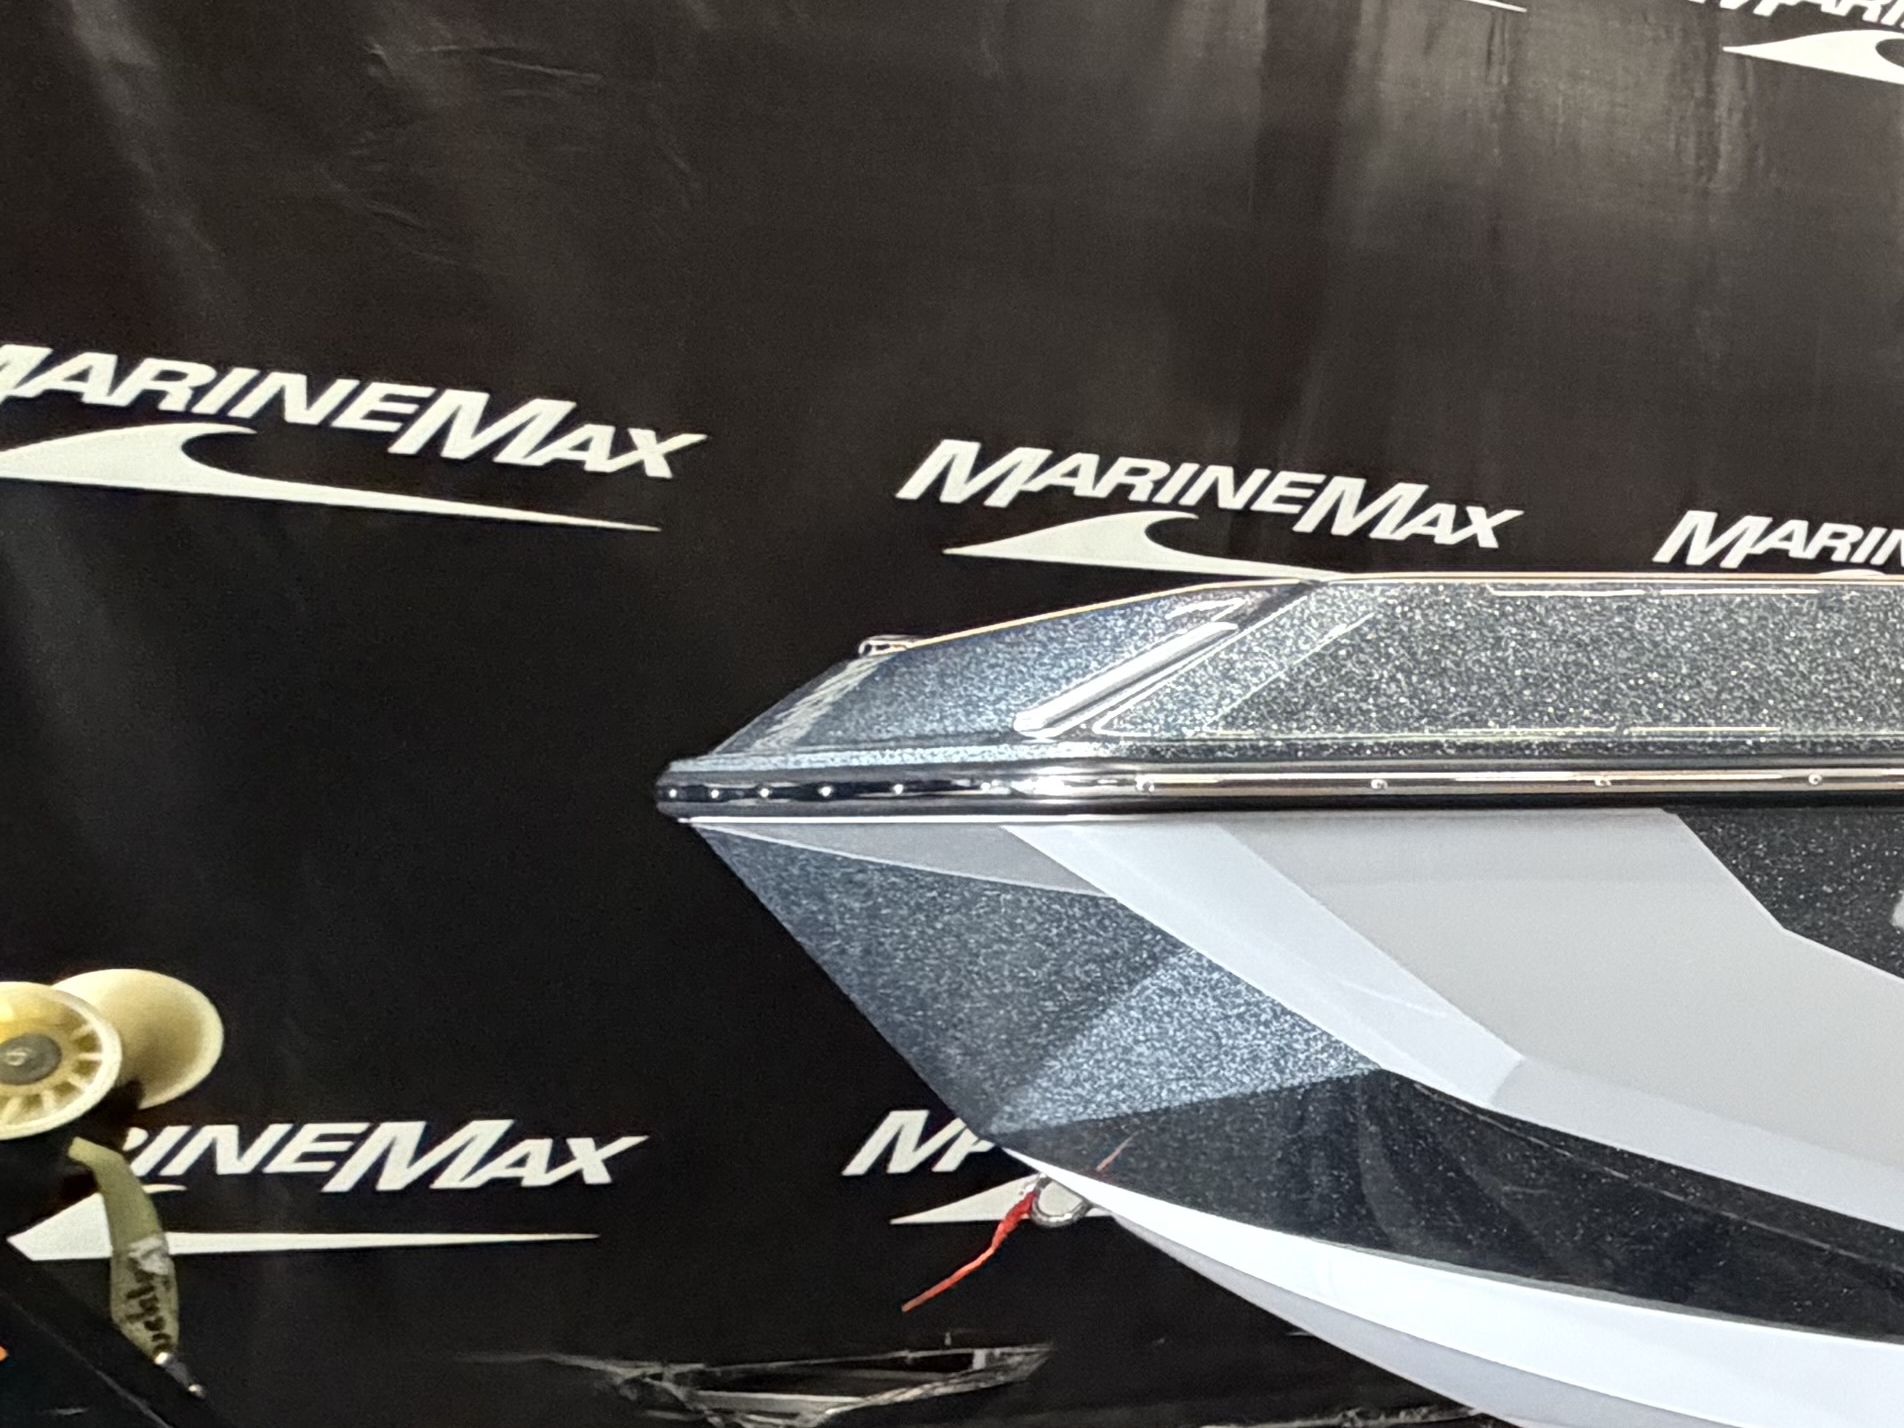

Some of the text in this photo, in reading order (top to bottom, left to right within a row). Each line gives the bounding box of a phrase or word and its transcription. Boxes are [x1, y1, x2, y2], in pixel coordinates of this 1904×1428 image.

[0, 344, 707, 478] ARINEMAX
[896, 439, 1524, 548] MARINEMAX
[122, 1119, 648, 1192] INEMAX
